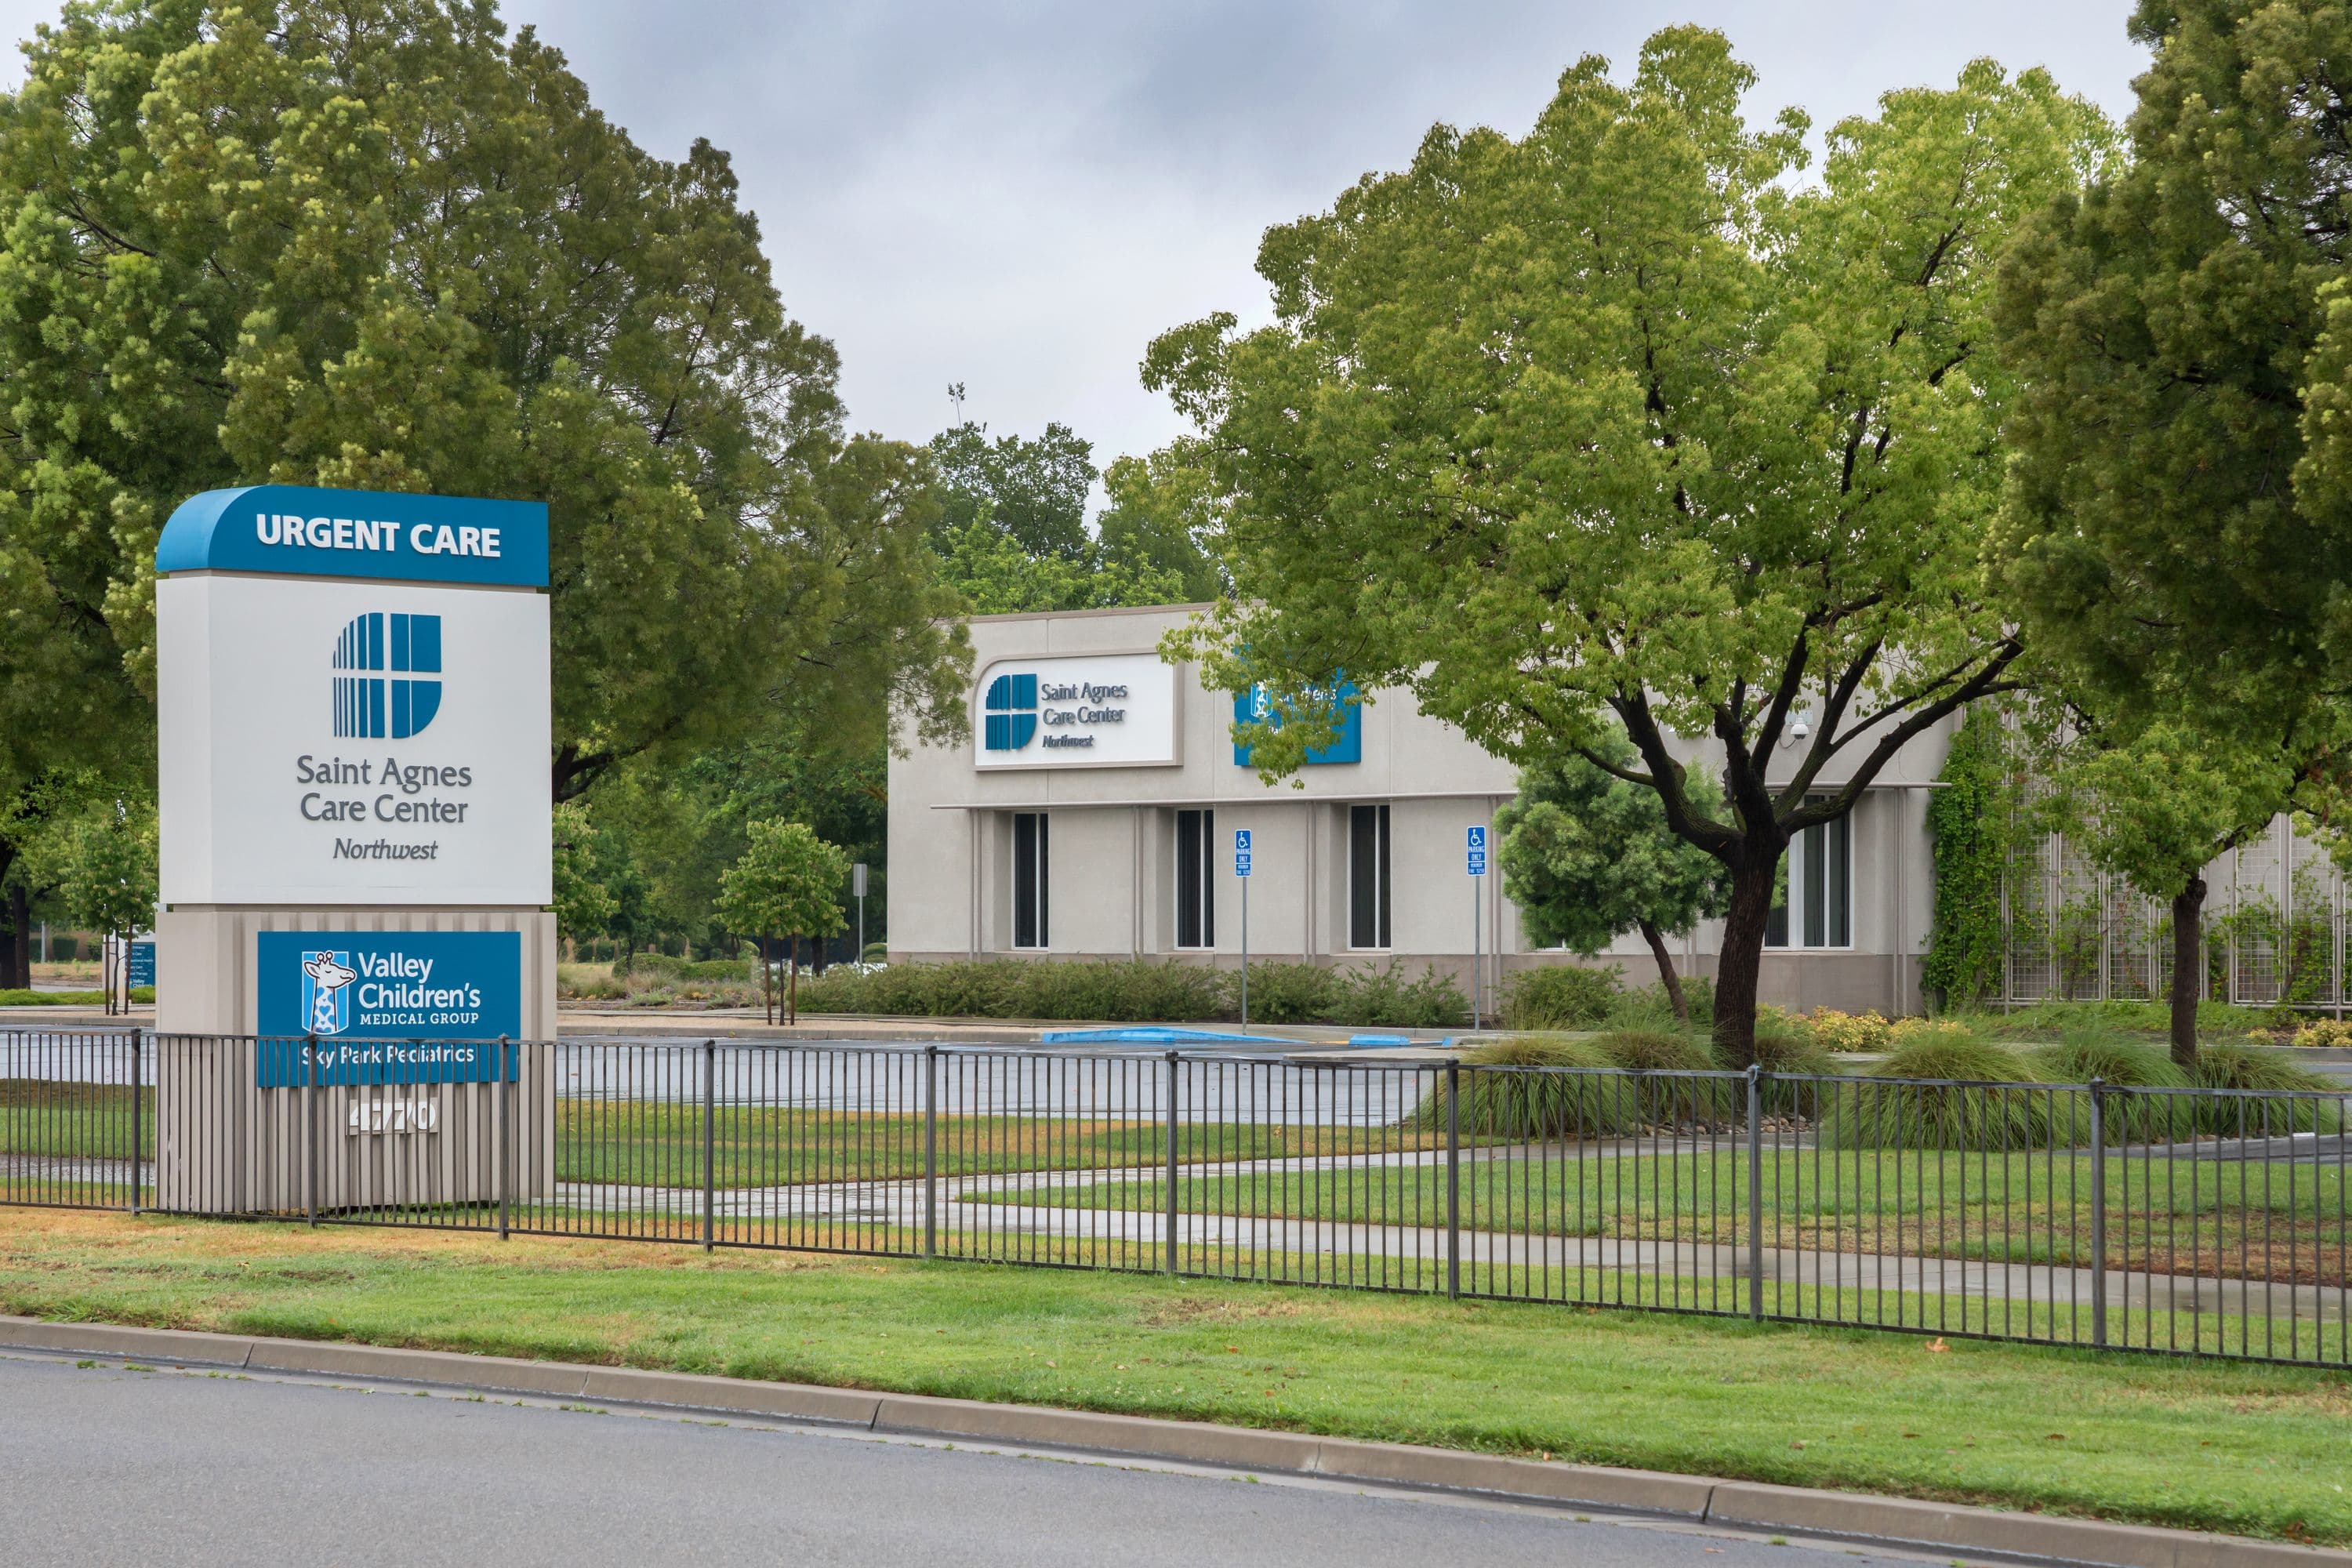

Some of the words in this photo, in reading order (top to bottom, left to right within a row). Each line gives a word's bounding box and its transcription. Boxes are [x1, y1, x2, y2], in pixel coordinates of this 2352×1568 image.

[256, 514, 400, 551] URGENT
[410, 523, 501, 557] CARE
[1041, 684, 1078, 701] Saint
[1080, 682, 1128, 704] Agnes
[1043, 708, 1076, 725] Care
[1077, 706, 1126, 723] Center
[1042, 735, 1094, 747] Northwest
[297, 754, 372, 784] Saint
[379, 757, 472, 794] Agnes
[300, 792, 366, 822] Care
[374, 793, 468, 823] Center
[332, 837, 438, 859] Northwest
[358, 952, 433, 984] Valley
[358, 982, 481, 1009] Children's
[360, 1013, 426, 1025] MEDICAL
[430, 1012, 480, 1025] GROUP
[340, 1045, 381, 1065] Park
[348, 1101, 437, 1131] 4770
